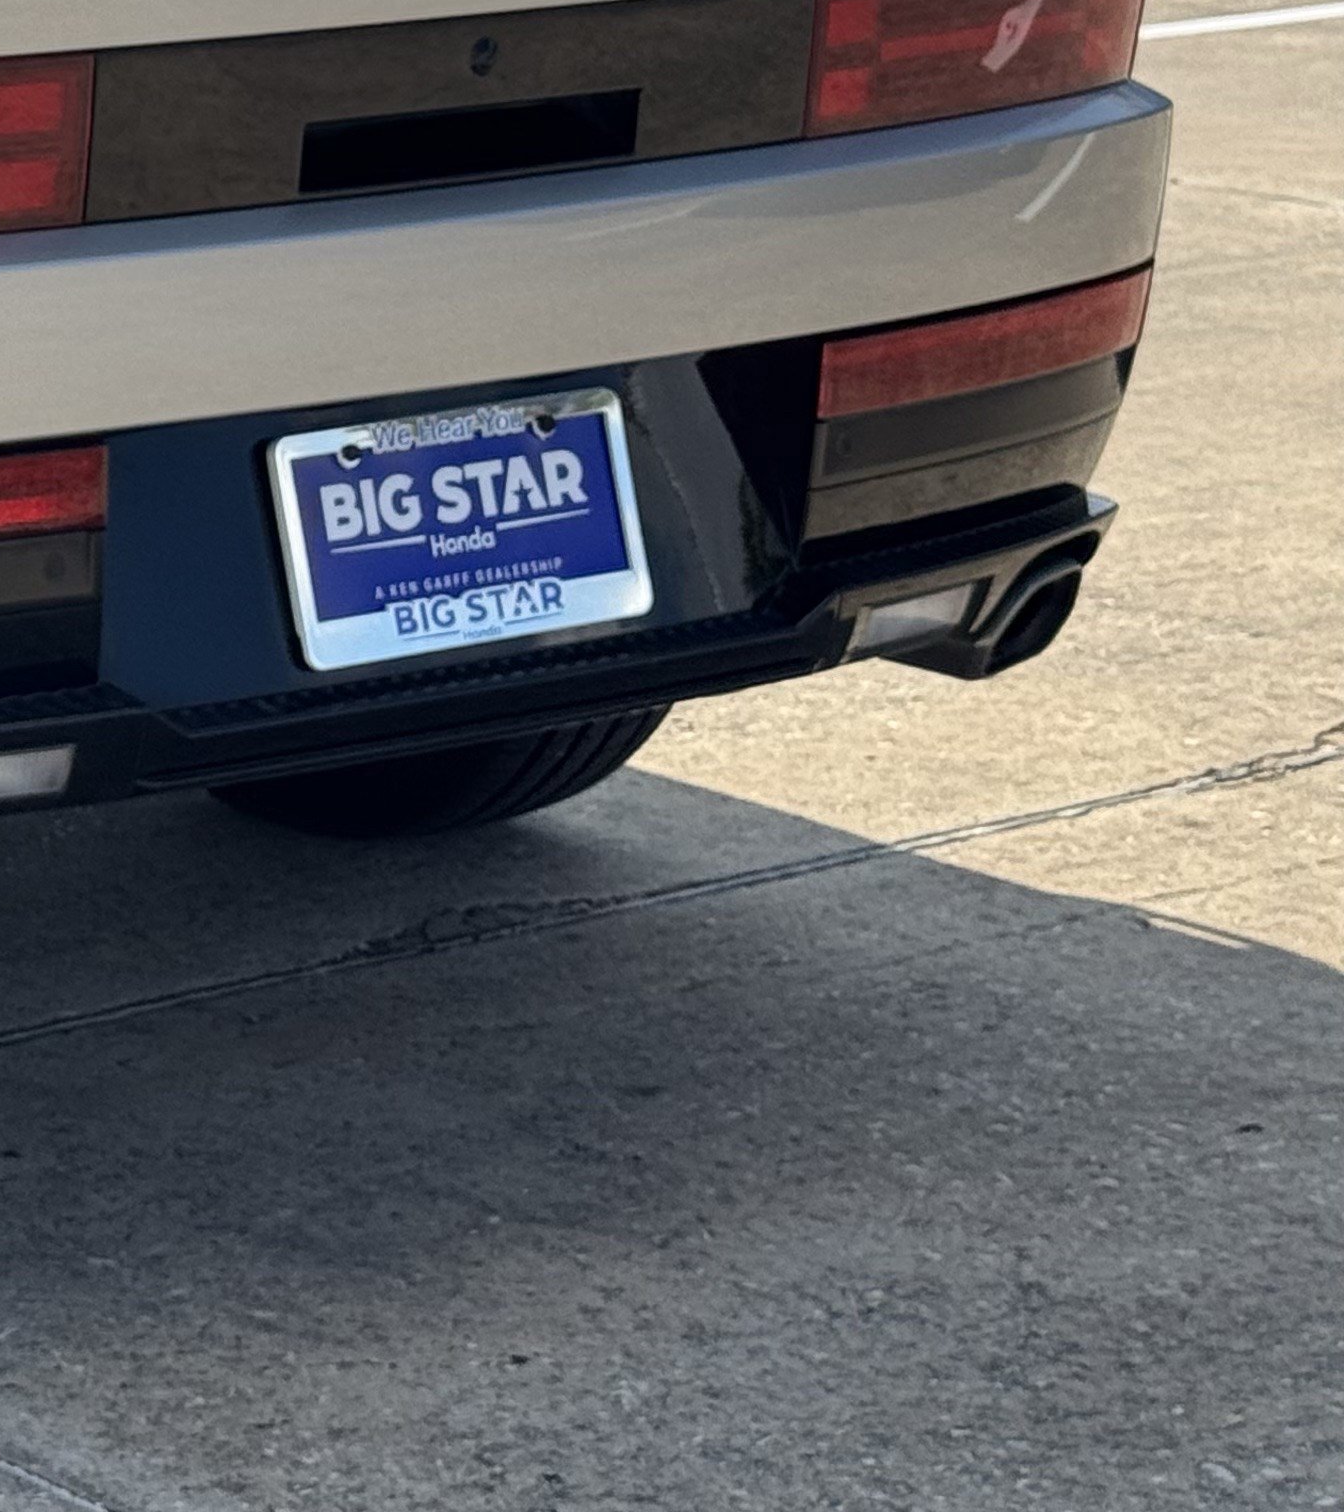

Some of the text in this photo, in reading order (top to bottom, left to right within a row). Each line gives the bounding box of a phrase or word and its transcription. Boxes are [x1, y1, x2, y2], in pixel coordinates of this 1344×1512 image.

[372, 408, 524, 450] We Hear You
[319, 449, 588, 543] BIG STAR
[430, 525, 496, 557] Honda
[394, 581, 565, 635] BIG STAR
